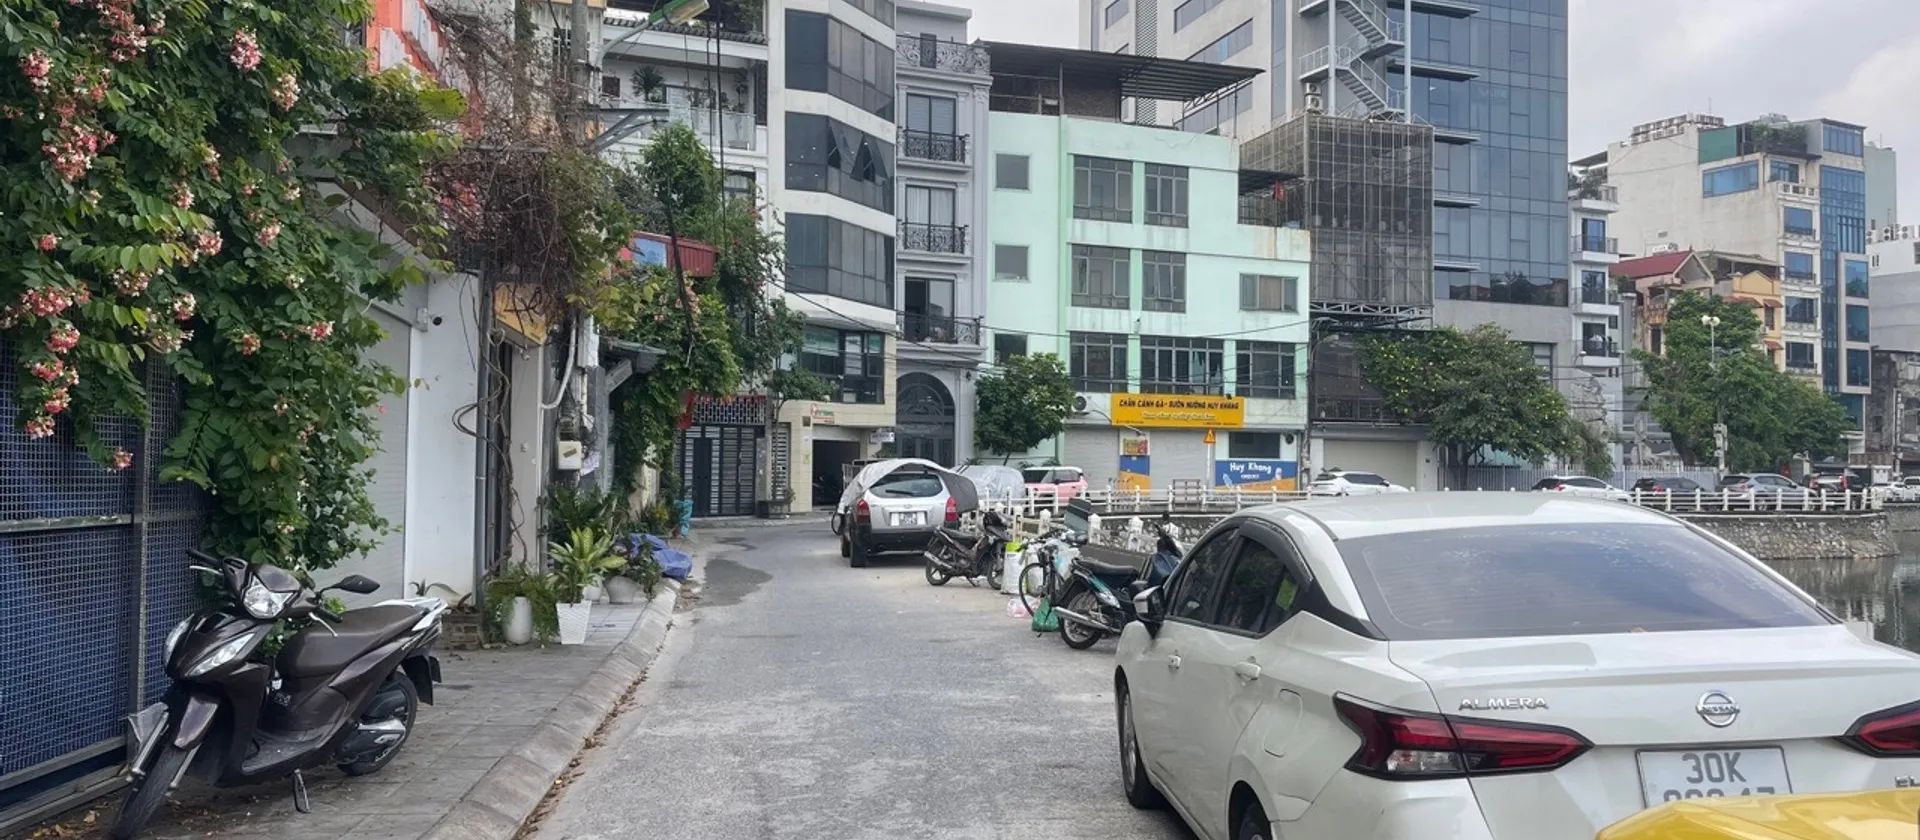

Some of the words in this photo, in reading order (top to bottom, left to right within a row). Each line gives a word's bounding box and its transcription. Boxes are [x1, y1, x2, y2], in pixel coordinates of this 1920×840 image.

[1230, 462, 1245, 474] Huy
[1248, 462, 1272, 476] Khang
[1459, 697, 1549, 710] ALMERA
[1700, 703, 1737, 714] NISSAN
[1681, 751, 1747, 784] 30K
